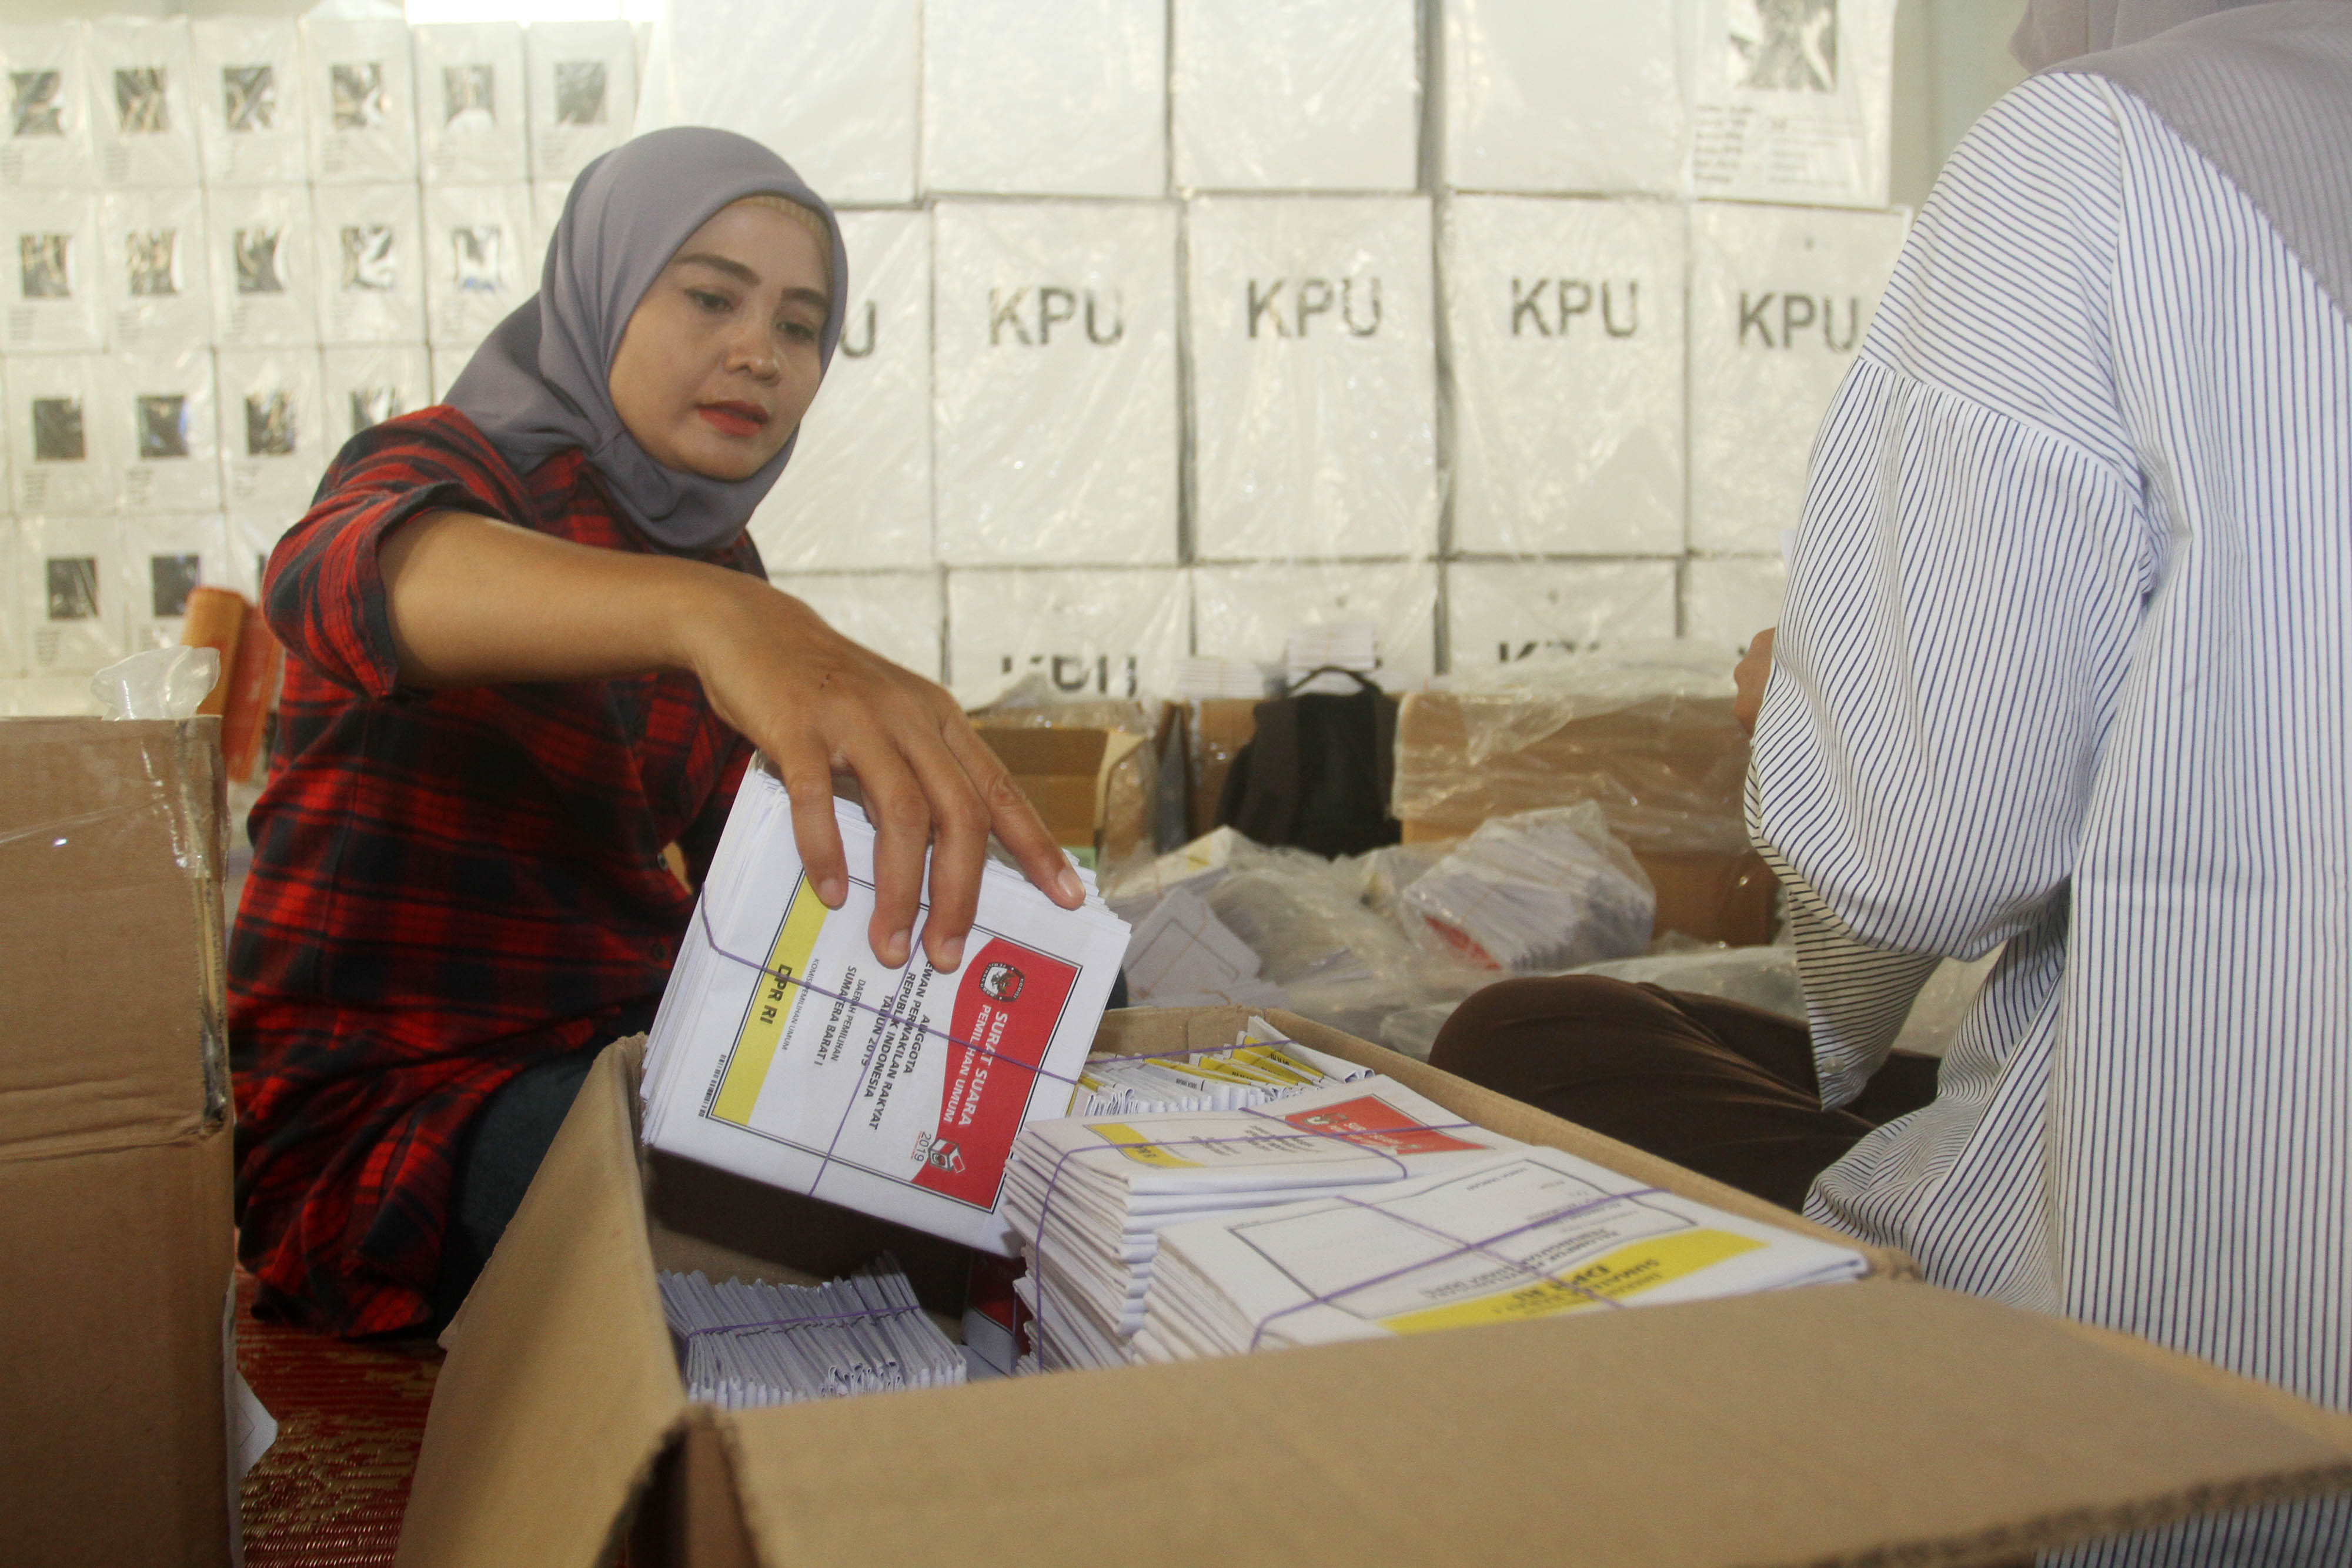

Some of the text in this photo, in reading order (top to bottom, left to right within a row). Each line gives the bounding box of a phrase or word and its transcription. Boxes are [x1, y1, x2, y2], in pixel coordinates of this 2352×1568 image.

[988, 285, 1125, 347] KPU
[1245, 276, 1382, 339] KPU
[1510, 278, 1639, 339] KPU
[1738, 292, 1861, 353] KPU
[759, 963, 792, 1024] DPR RI
[790, 984, 810, 1024] PEMILIHAN
[830, 978, 866, 1061] DAERAH PEMILIHAN
[780, 1025, 796, 1051] UMUM
[815, 1024, 837, 1060] BARAT
[860, 1037, 877, 1067] 2019
[863, 972, 916, 1099] REPUBLK INDONESIA
[868, 961, 935, 1130] EWAN PERWAKILAN RAKYAT
[903, 1014, 930, 1075] ANGGOTA
[943, 1004, 991, 1123] PEMILHAN UMUM
[958, 1010, 1008, 1128] SURAT SUARA
[913, 1131, 931, 1162] 2019
